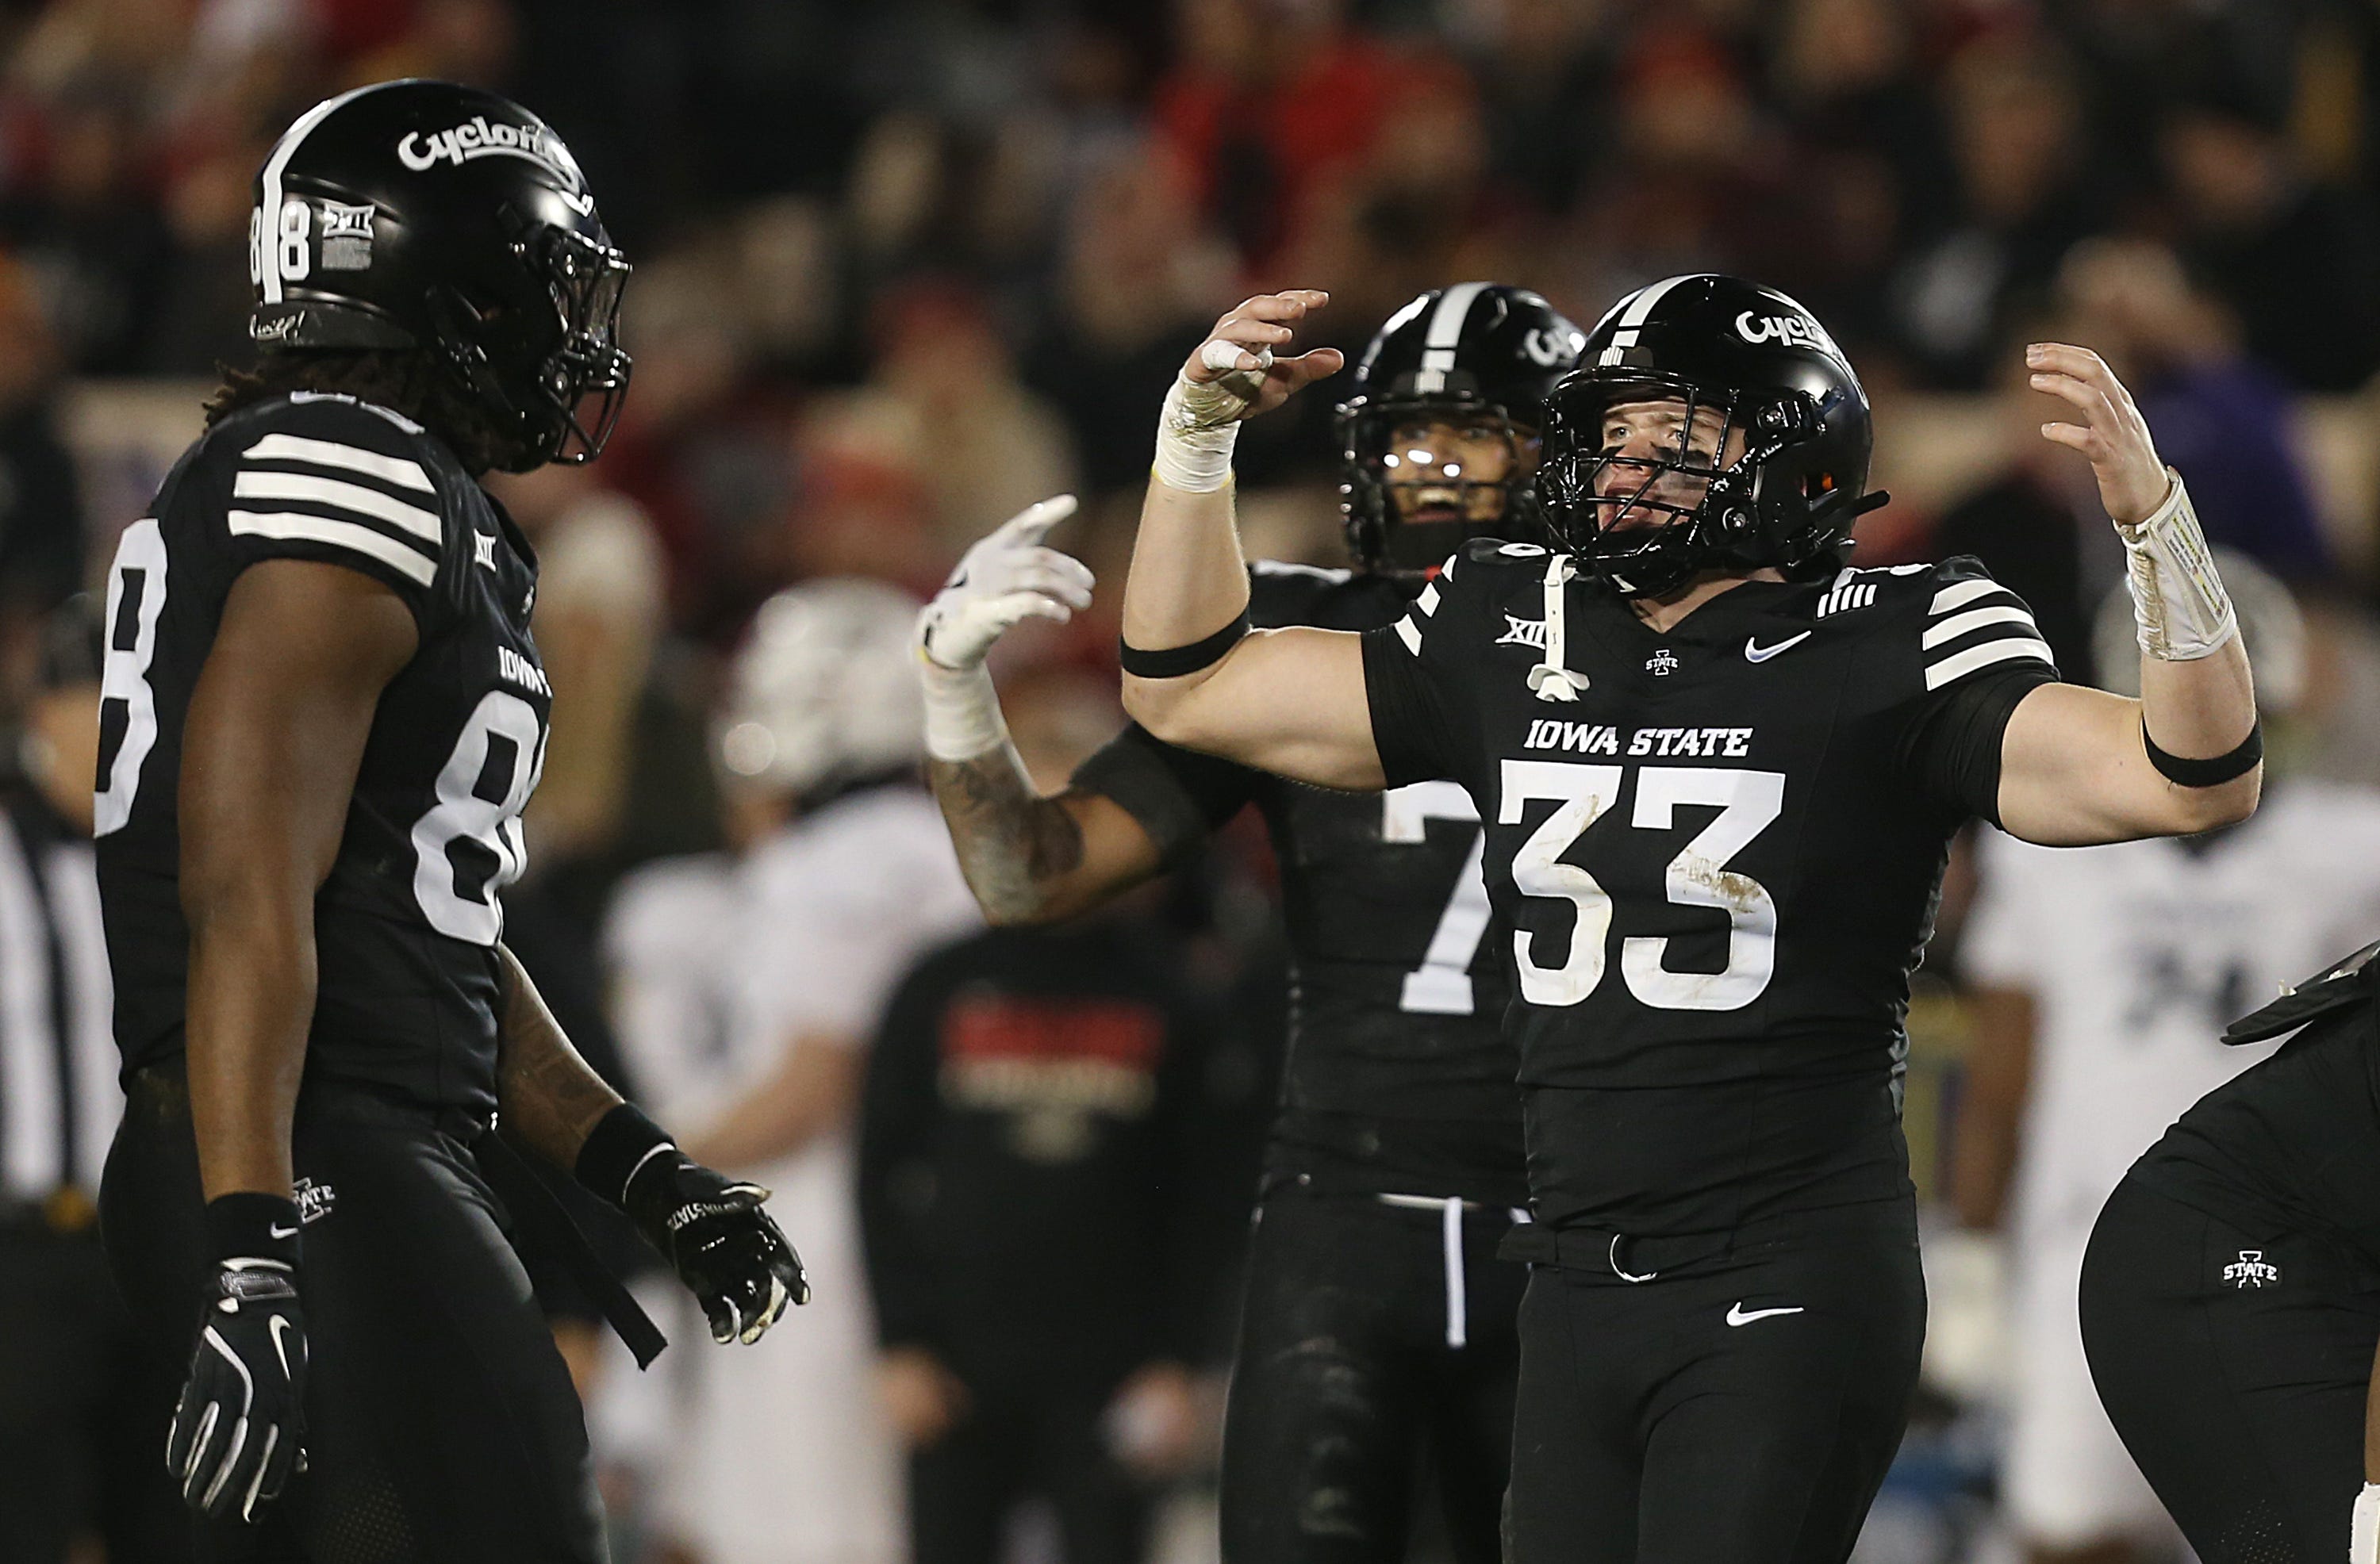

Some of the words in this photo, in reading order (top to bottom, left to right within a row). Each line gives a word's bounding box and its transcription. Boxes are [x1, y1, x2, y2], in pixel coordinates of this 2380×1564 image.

[1645, 657, 1678, 671] STATE
[1523, 719, 1619, 754] IOWA
[1627, 728, 1753, 757] STATE
[1382, 780, 1493, 1014] 7
[1499, 759, 1786, 1011] 33
[2223, 1262, 2277, 1282] STATE
